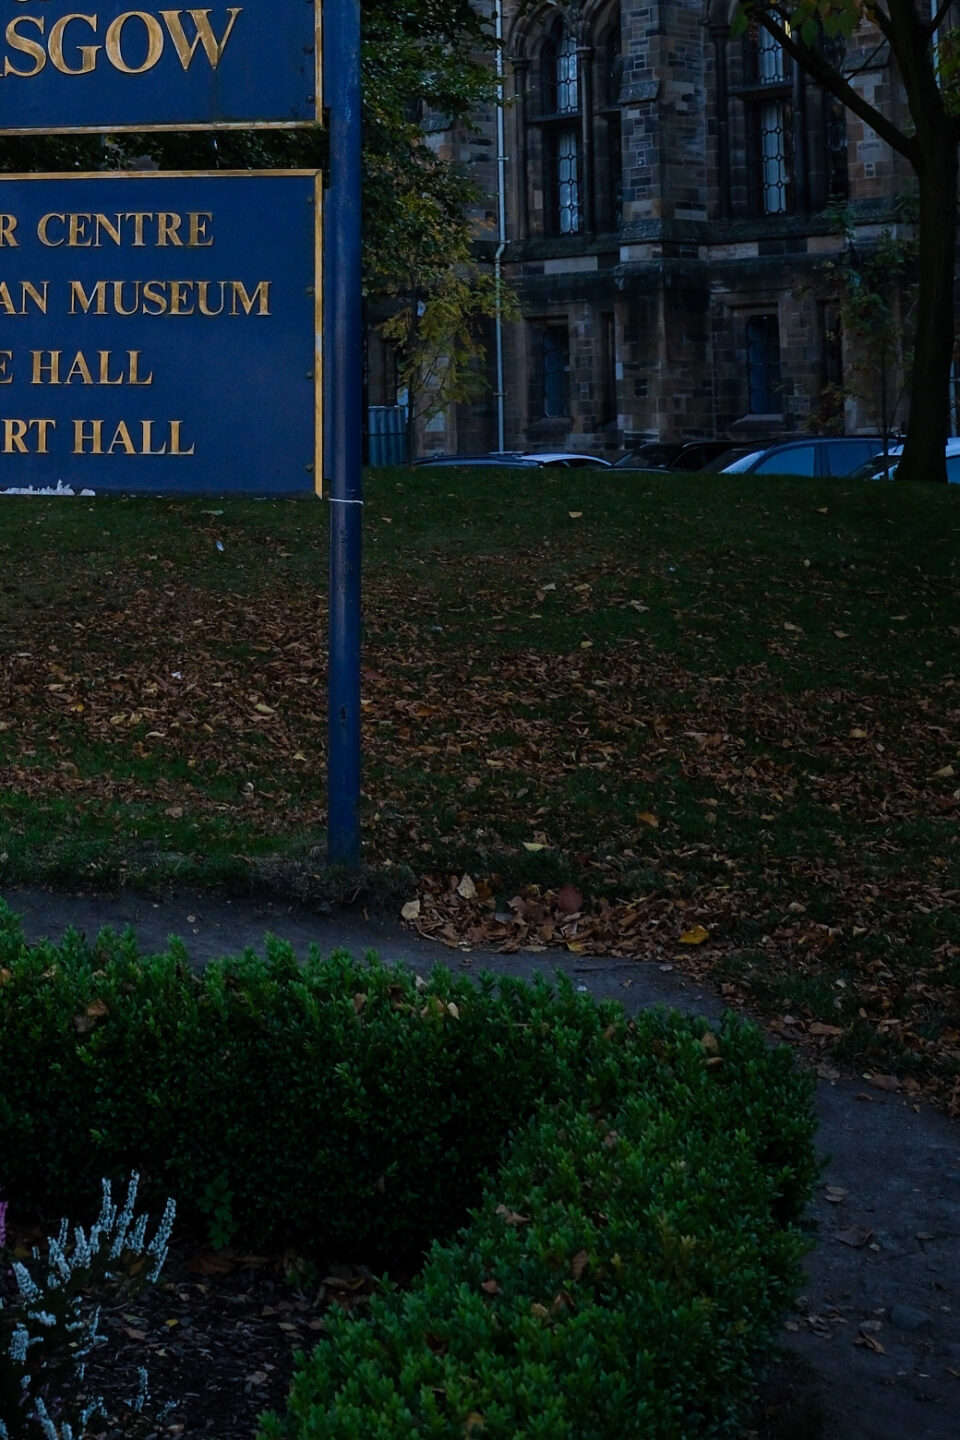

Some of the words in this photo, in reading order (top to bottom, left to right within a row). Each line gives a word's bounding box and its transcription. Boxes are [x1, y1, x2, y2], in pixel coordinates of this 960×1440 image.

[38, 213, 213, 246] CENTRE
[69, 281, 271, 315] MUSEUM
[30, 351, 152, 384] HALL
[72, 420, 194, 454] HALL
